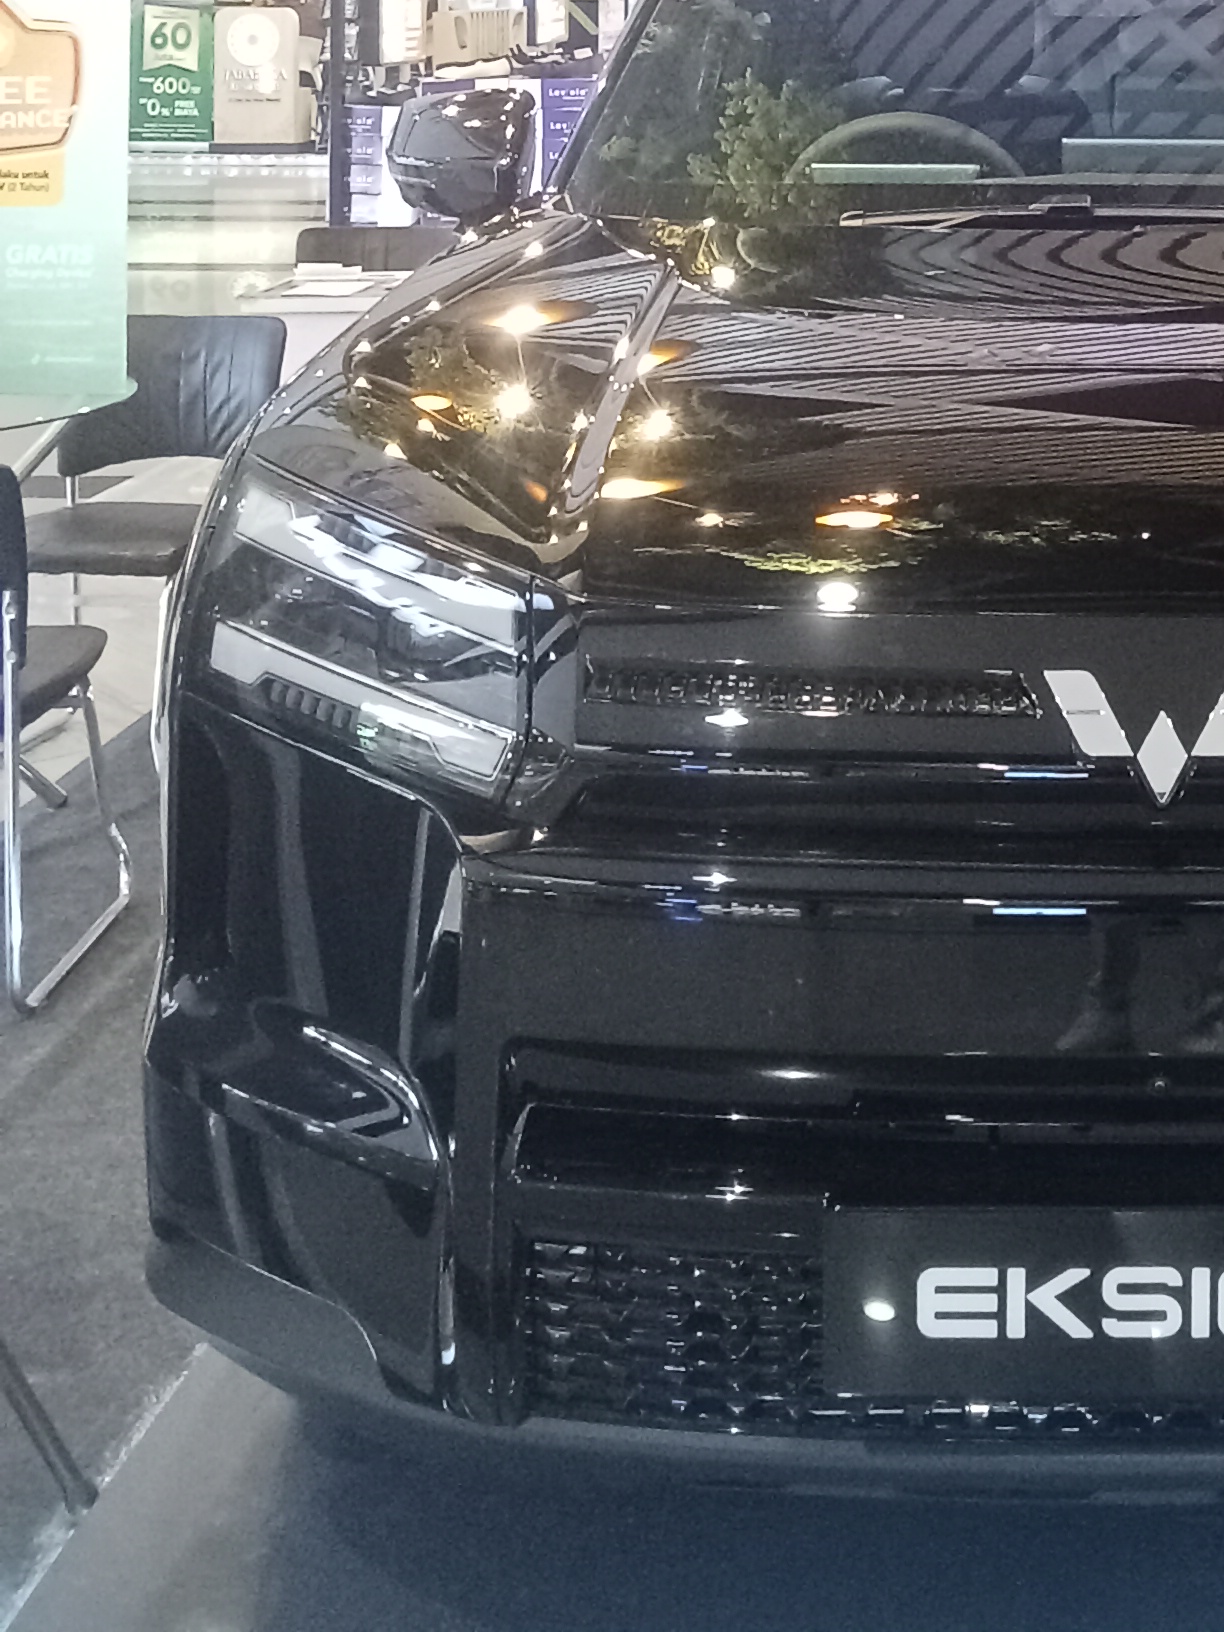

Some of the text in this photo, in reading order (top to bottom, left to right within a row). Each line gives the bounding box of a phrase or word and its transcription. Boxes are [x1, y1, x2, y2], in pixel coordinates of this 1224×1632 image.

[150, 22, 192, 51] 60
[152, 77, 191, 95] 600
[22, 170, 49, 179] untuk
[6, 244, 95, 265] GRATIS
